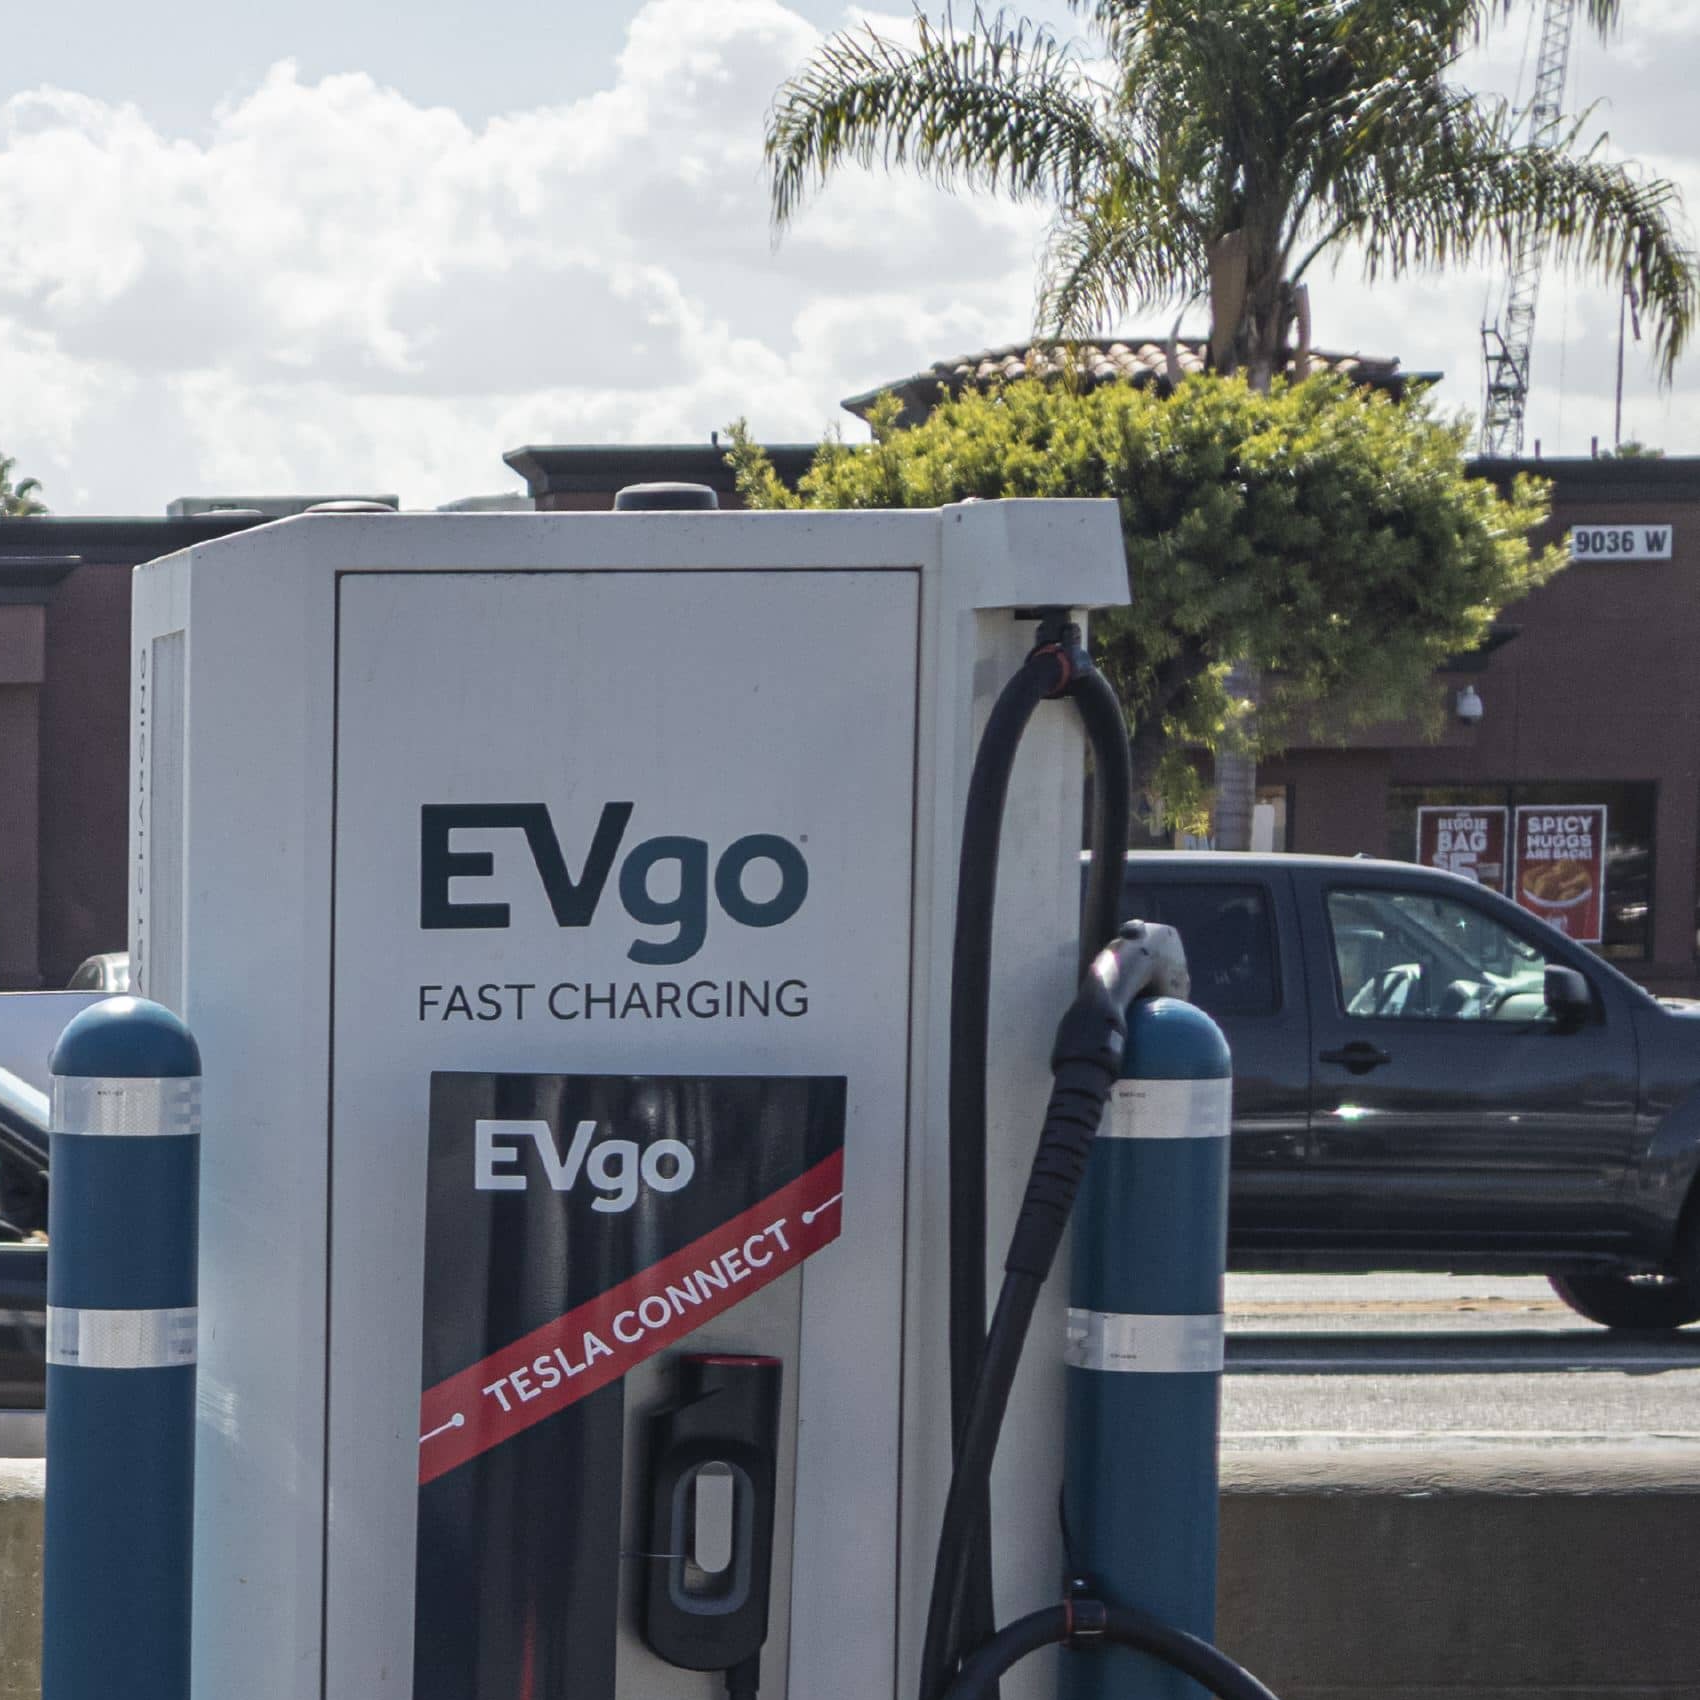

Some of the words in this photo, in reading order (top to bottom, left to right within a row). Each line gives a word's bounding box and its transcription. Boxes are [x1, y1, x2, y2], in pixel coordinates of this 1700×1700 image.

[1575, 530, 1635, 554] 9036
[1645, 530, 1668, 553] W
[1438, 831, 1488, 852] BAG
[1527, 815, 1593, 834] SPICY
[419, 801, 809, 966] EVgo
[418, 983, 536, 1022] FAST
[547, 978, 810, 1021] CHARGING
[474, 1118, 696, 1213] EVgo
[481, 1330, 615, 1413] TESLA
[611, 1217, 793, 1344] CONNECT
